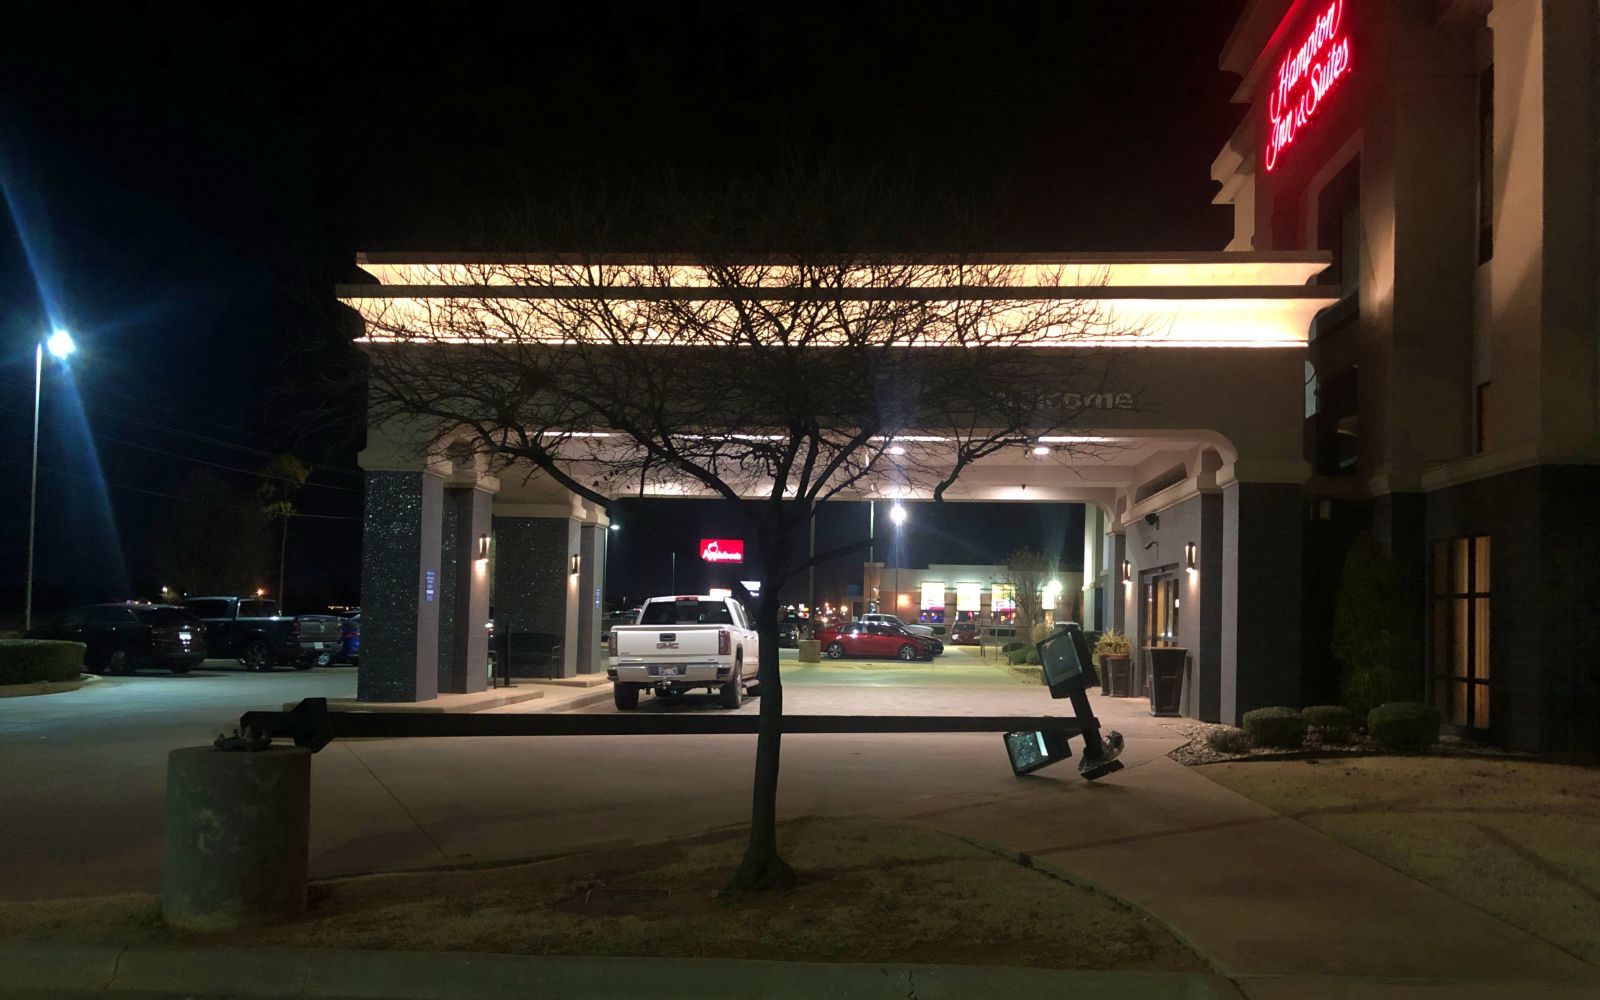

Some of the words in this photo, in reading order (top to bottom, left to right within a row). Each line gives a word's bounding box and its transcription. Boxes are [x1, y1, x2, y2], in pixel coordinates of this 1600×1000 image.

[1266, 107, 1297, 171] Inn
[1306, 37, 1350, 116] Suites
[1270, 0, 1343, 123] Hampton
